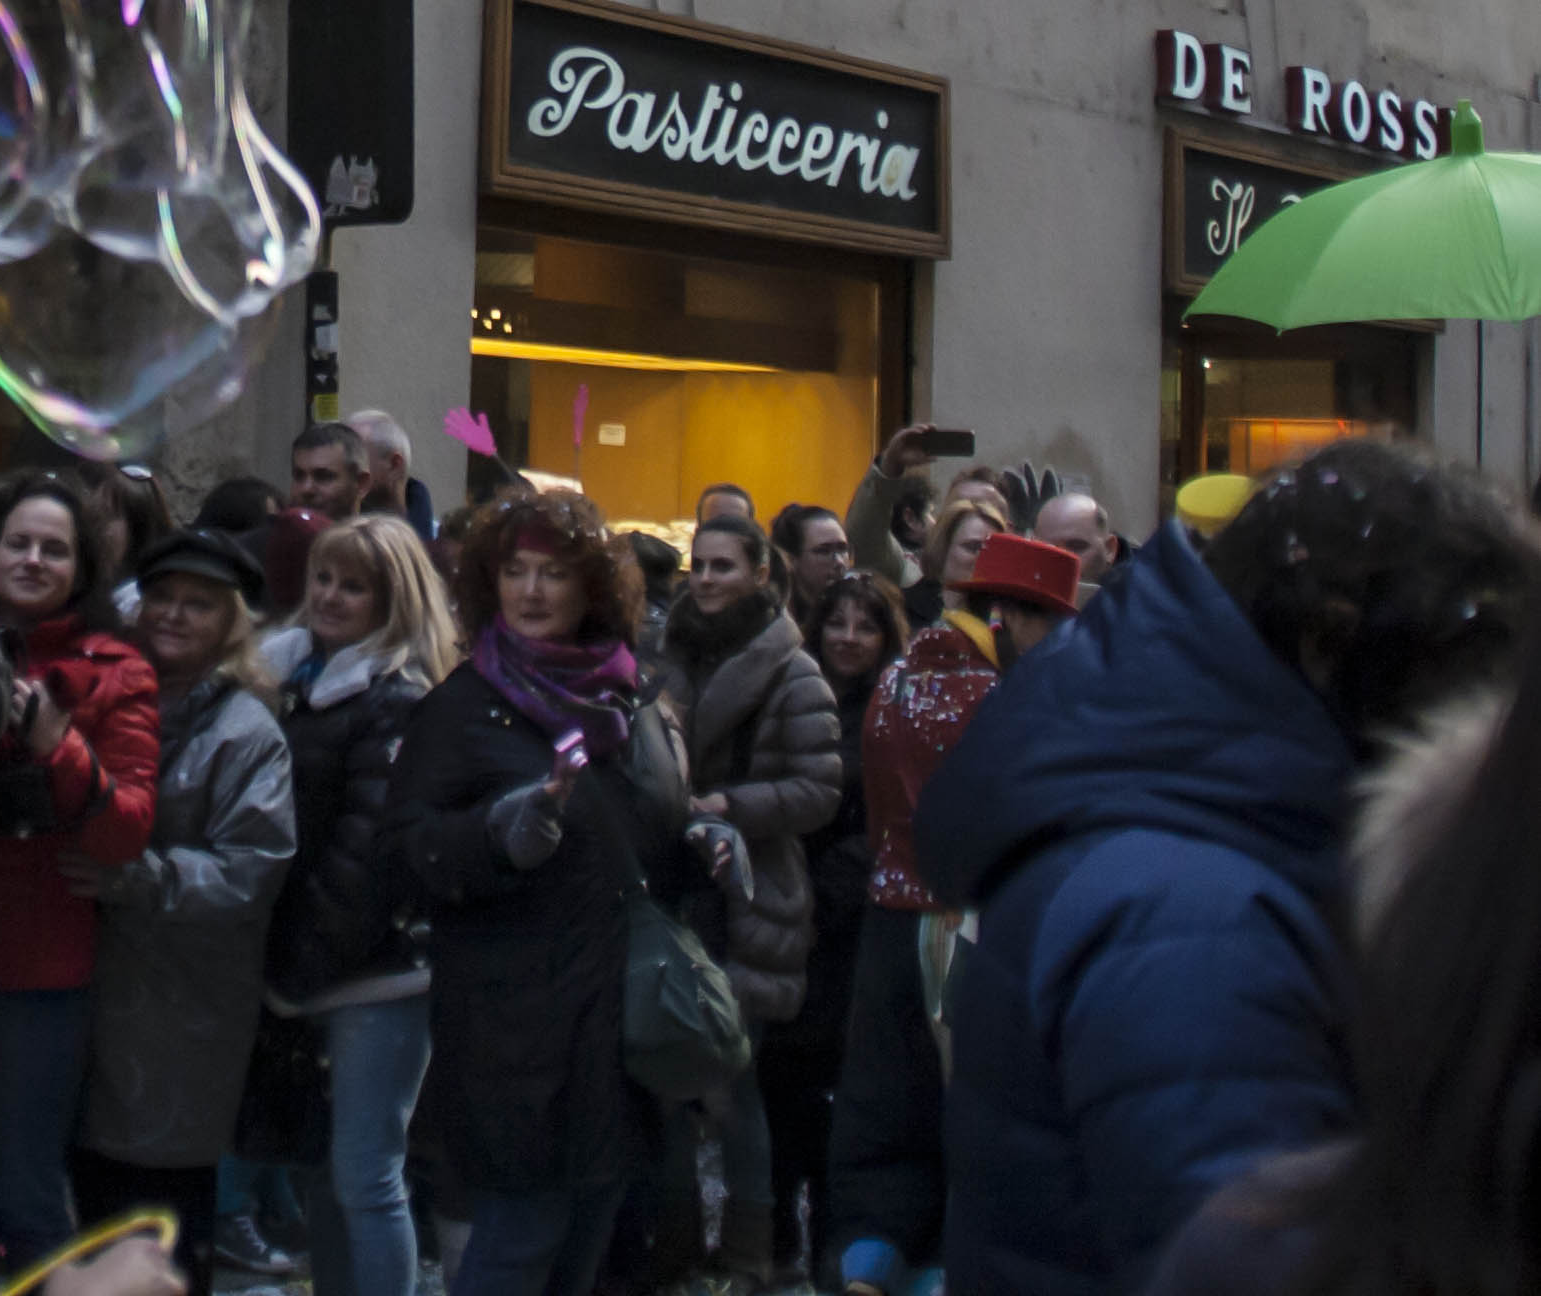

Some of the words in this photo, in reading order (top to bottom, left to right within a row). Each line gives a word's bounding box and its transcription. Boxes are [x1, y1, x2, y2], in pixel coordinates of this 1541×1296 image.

[527, 46, 920, 201] Pasticceria
[1171, 30, 1252, 115] DE
[1301, 66, 1456, 161] ROSS
